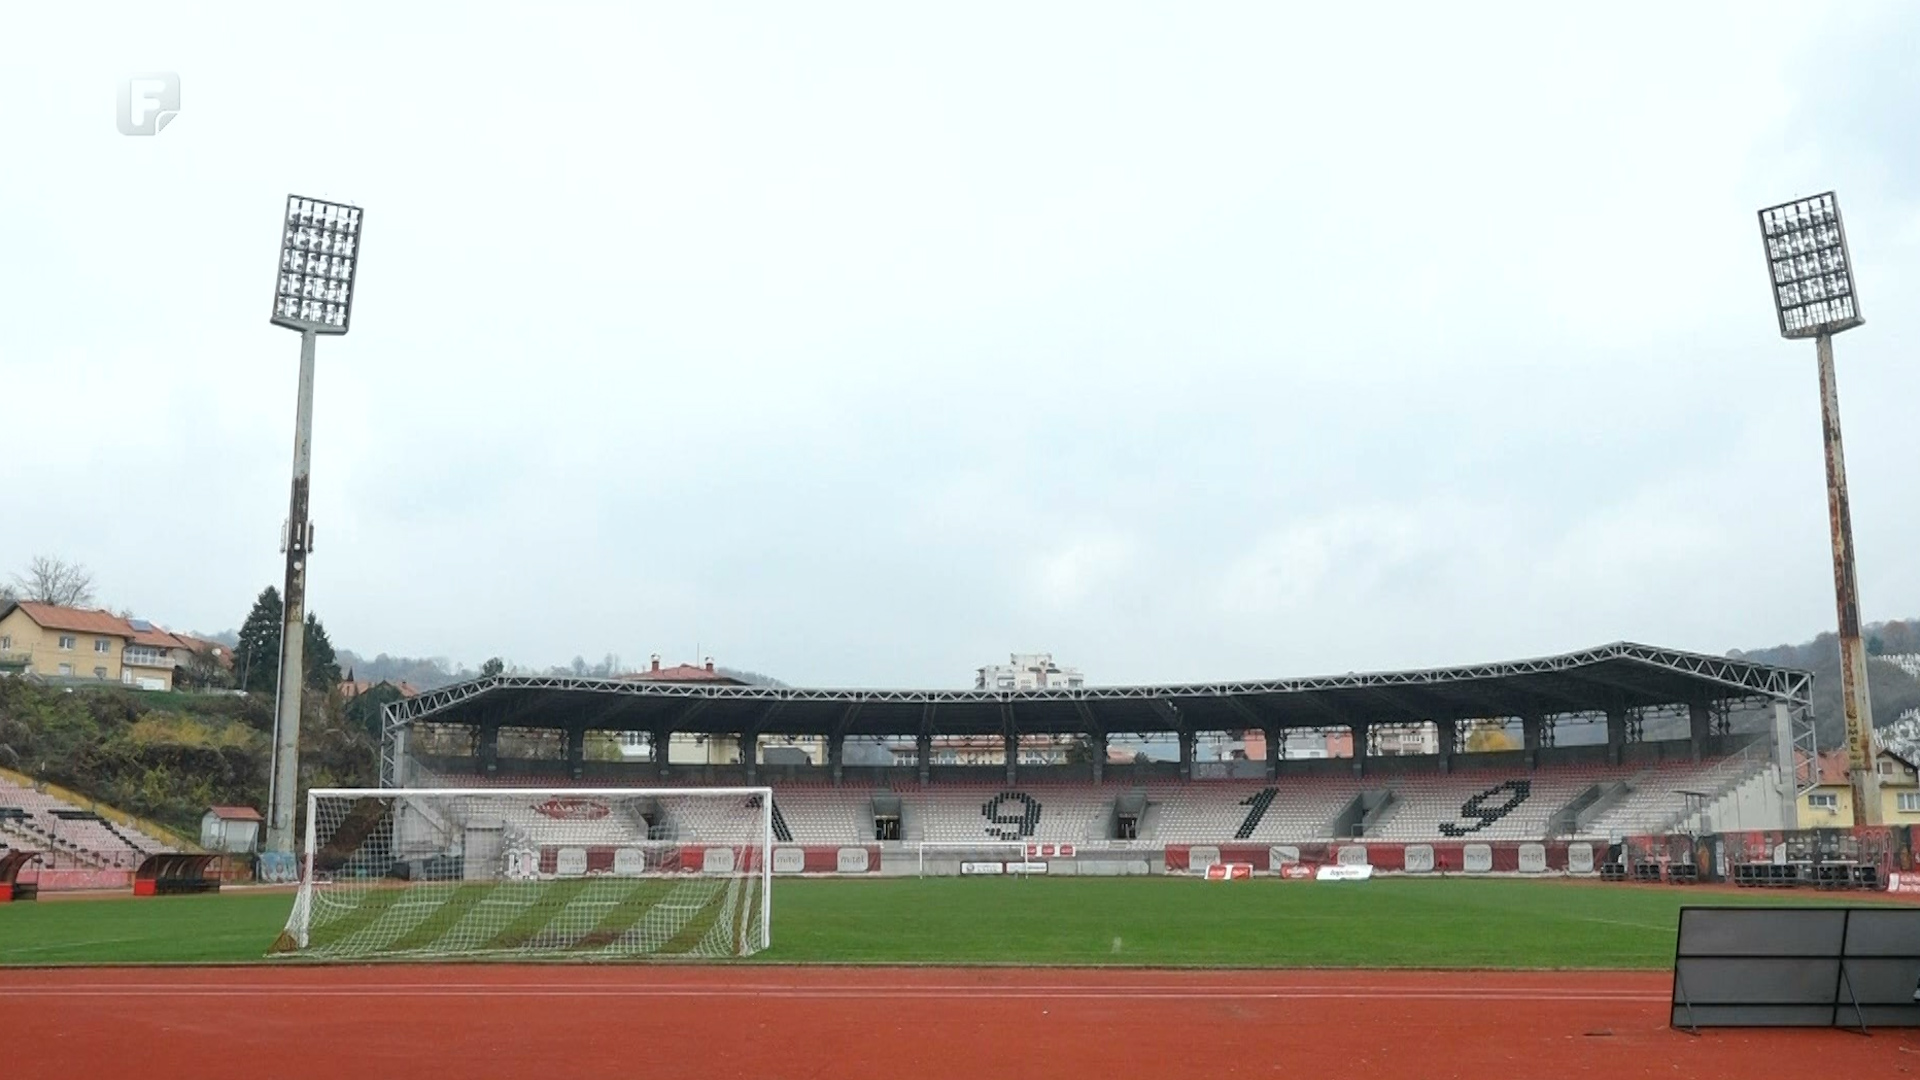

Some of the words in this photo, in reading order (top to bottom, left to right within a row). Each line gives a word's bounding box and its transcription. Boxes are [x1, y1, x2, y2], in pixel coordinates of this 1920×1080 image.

[981, 792, 1041, 841] 9
[1234, 787, 1279, 839] 1
[1438, 780, 1531, 837] 9
